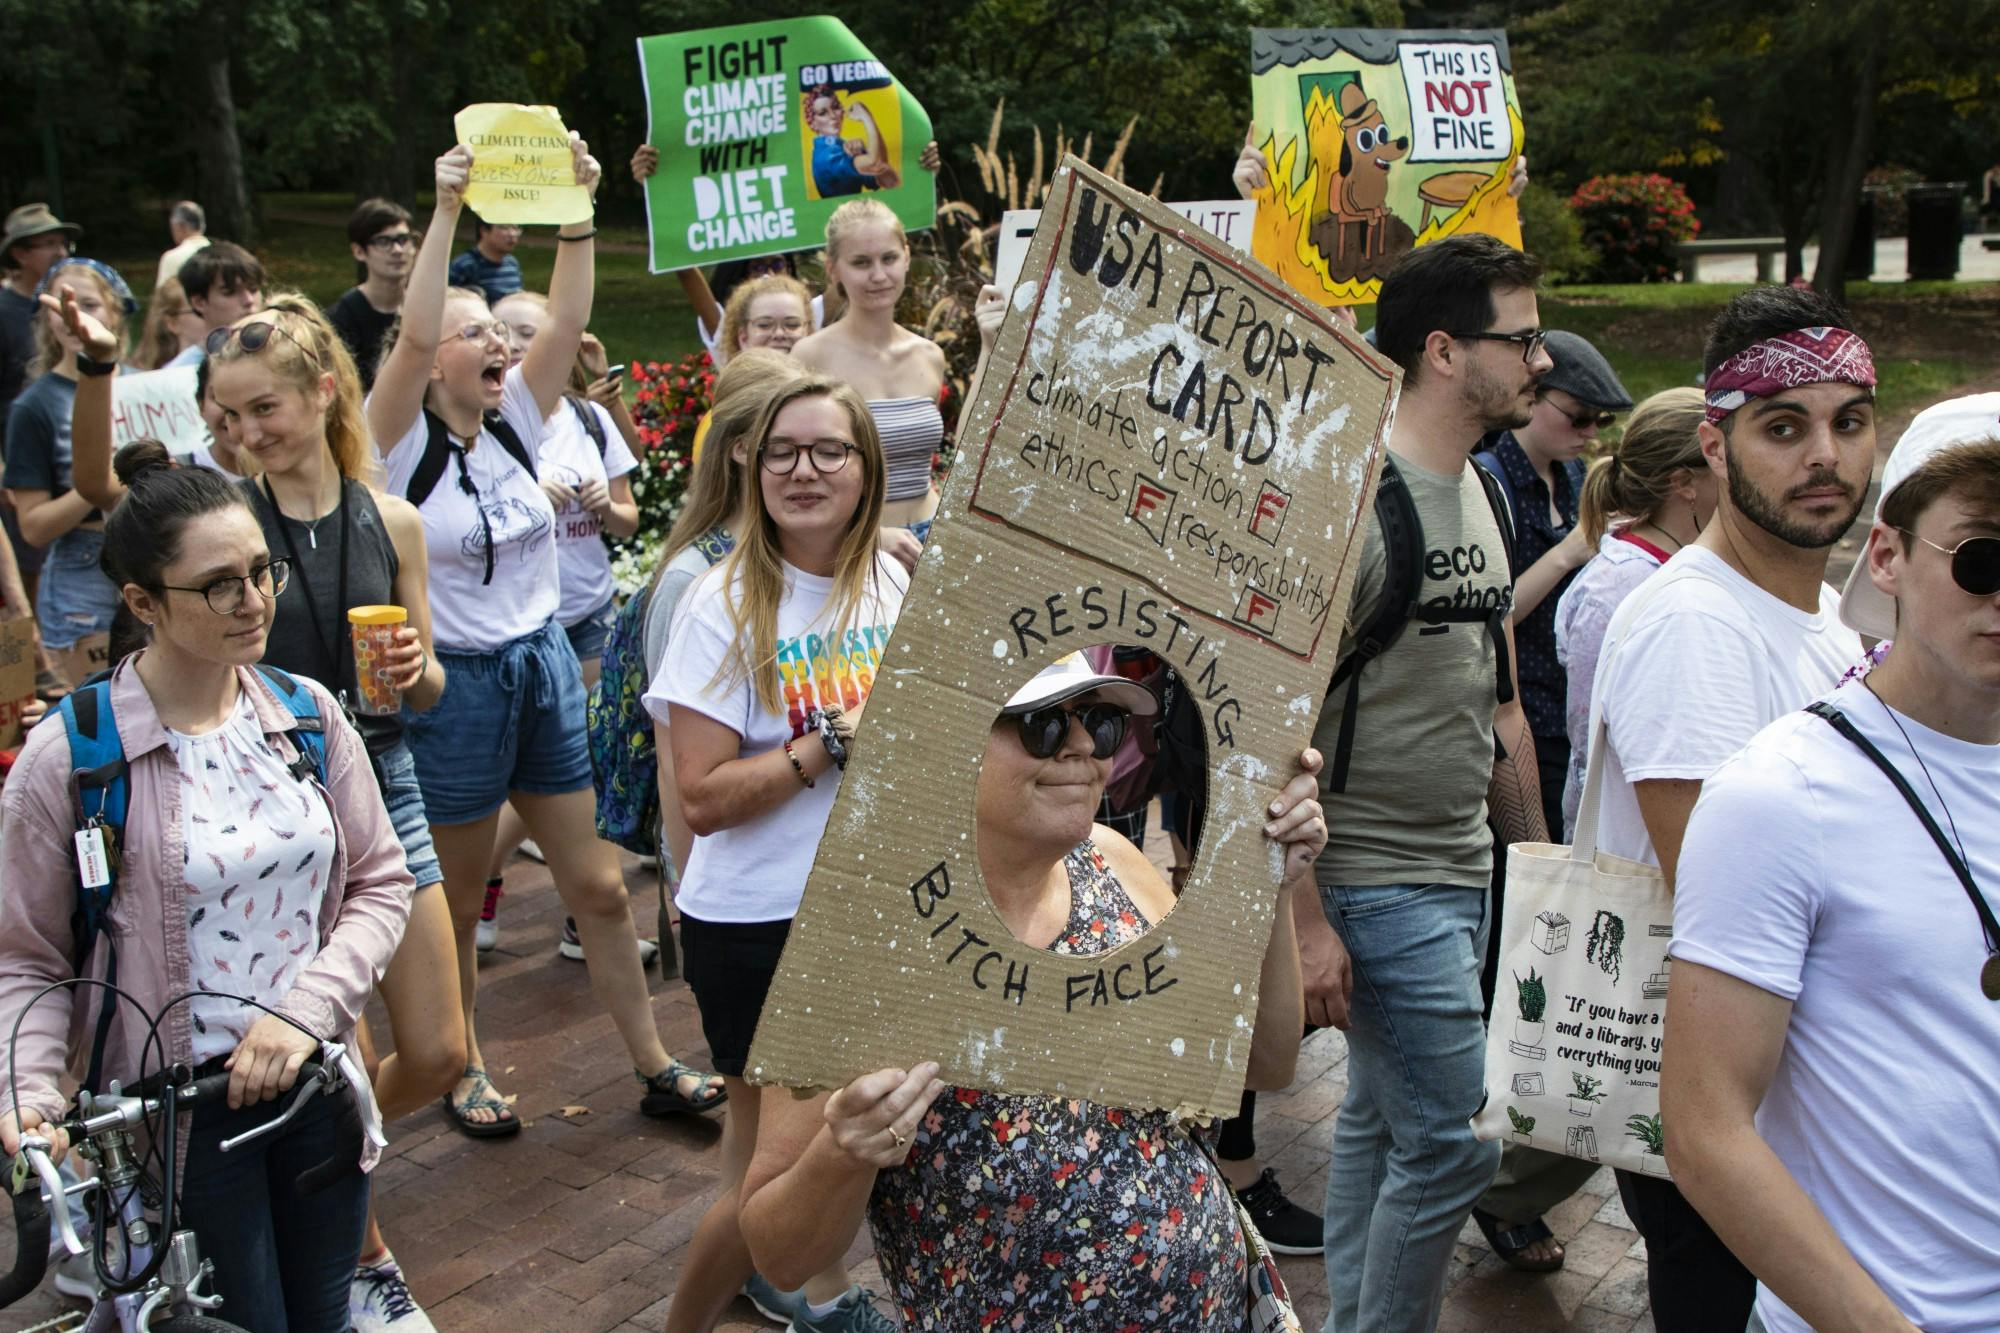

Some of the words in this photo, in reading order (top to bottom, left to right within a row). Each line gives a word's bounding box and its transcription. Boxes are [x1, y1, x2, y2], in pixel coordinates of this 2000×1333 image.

[683, 35, 789, 86] FIGHT
[801, 65, 826, 86] GO
[831, 60, 891, 83] VEGAN
[1413, 50, 1464, 76] THIS
[1471, 51, 1492, 76] IS
[683, 73, 787, 118] CLIMATE
[1424, 80, 1492, 117] NOT
[469, 134, 527, 148] CLIMATE
[685, 103, 788, 147] CHANGE
[1432, 117, 1496, 150] FINE
[514, 154, 525, 166] IS
[700, 138, 768, 175] WITH
[504, 188, 541, 200] ISSUE!
[693, 165, 788, 221] DIET
[687, 208, 797, 252] CHANGE
[1069, 188, 1164, 308] USA
[1176, 261, 1336, 415] REPORT
[1146, 344, 1278, 466] CARD
[1026, 360, 1137, 449] climate
[1152, 435, 1243, 518] action
[1251, 491, 1286, 534] F
[1020, 432, 1120, 501] ethics
[1131, 484, 1166, 518] F
[1177, 511, 1330, 624] responsibility
[1424, 544, 1486, 581] eco
[1246, 592, 1276, 624] F
[1008, 586, 1241, 749] RESISTING
[910, 861, 1029, 1006] BITCH
[1066, 944, 1179, 1013] FACE
[1556, 1021, 1583, 1038] and
[1585, 1028, 1594, 1039] a
[1588, 1004, 1616, 1020] you
[1618, 1006, 1649, 1025] have
[1651, 1013, 1659, 1025] a
[1557, 1046, 1632, 1075] everything
[1634, 1058, 1662, 1075] you
[1630, 1079, 1659, 1088] Marcus
